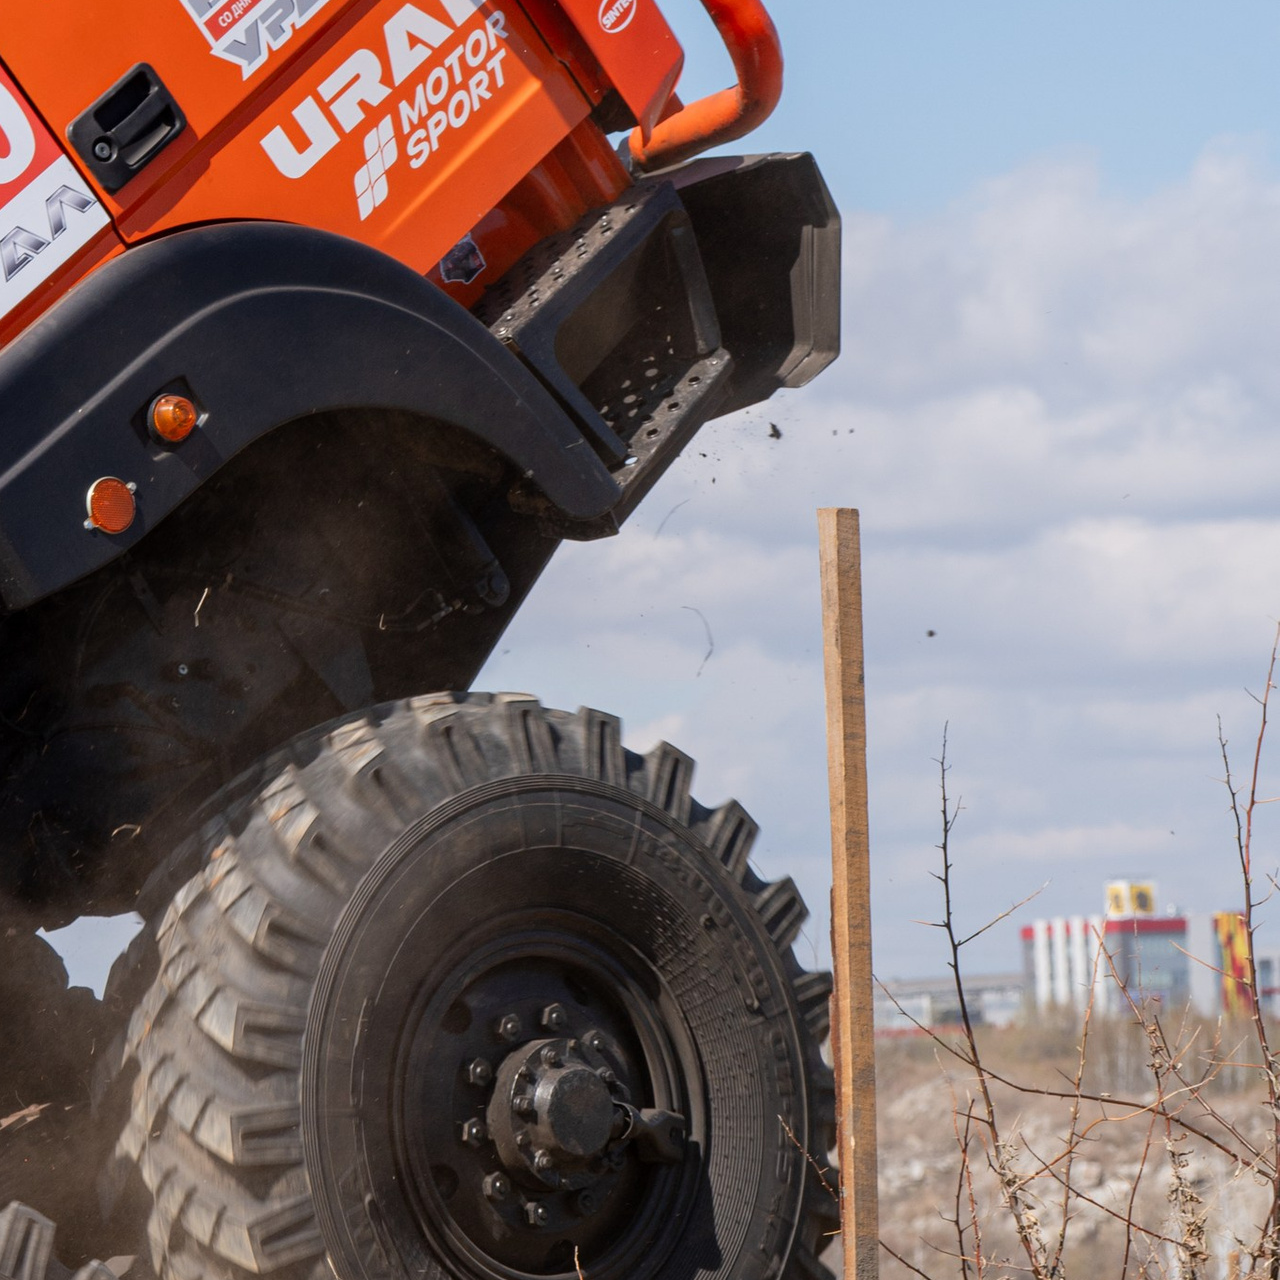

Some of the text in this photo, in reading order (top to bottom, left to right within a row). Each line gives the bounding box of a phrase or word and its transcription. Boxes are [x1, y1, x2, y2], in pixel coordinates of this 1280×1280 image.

[218, 11, 233, 27] СО
[398, 10, 509, 135] MOTOR
[406, 48, 506, 169] SPORT
